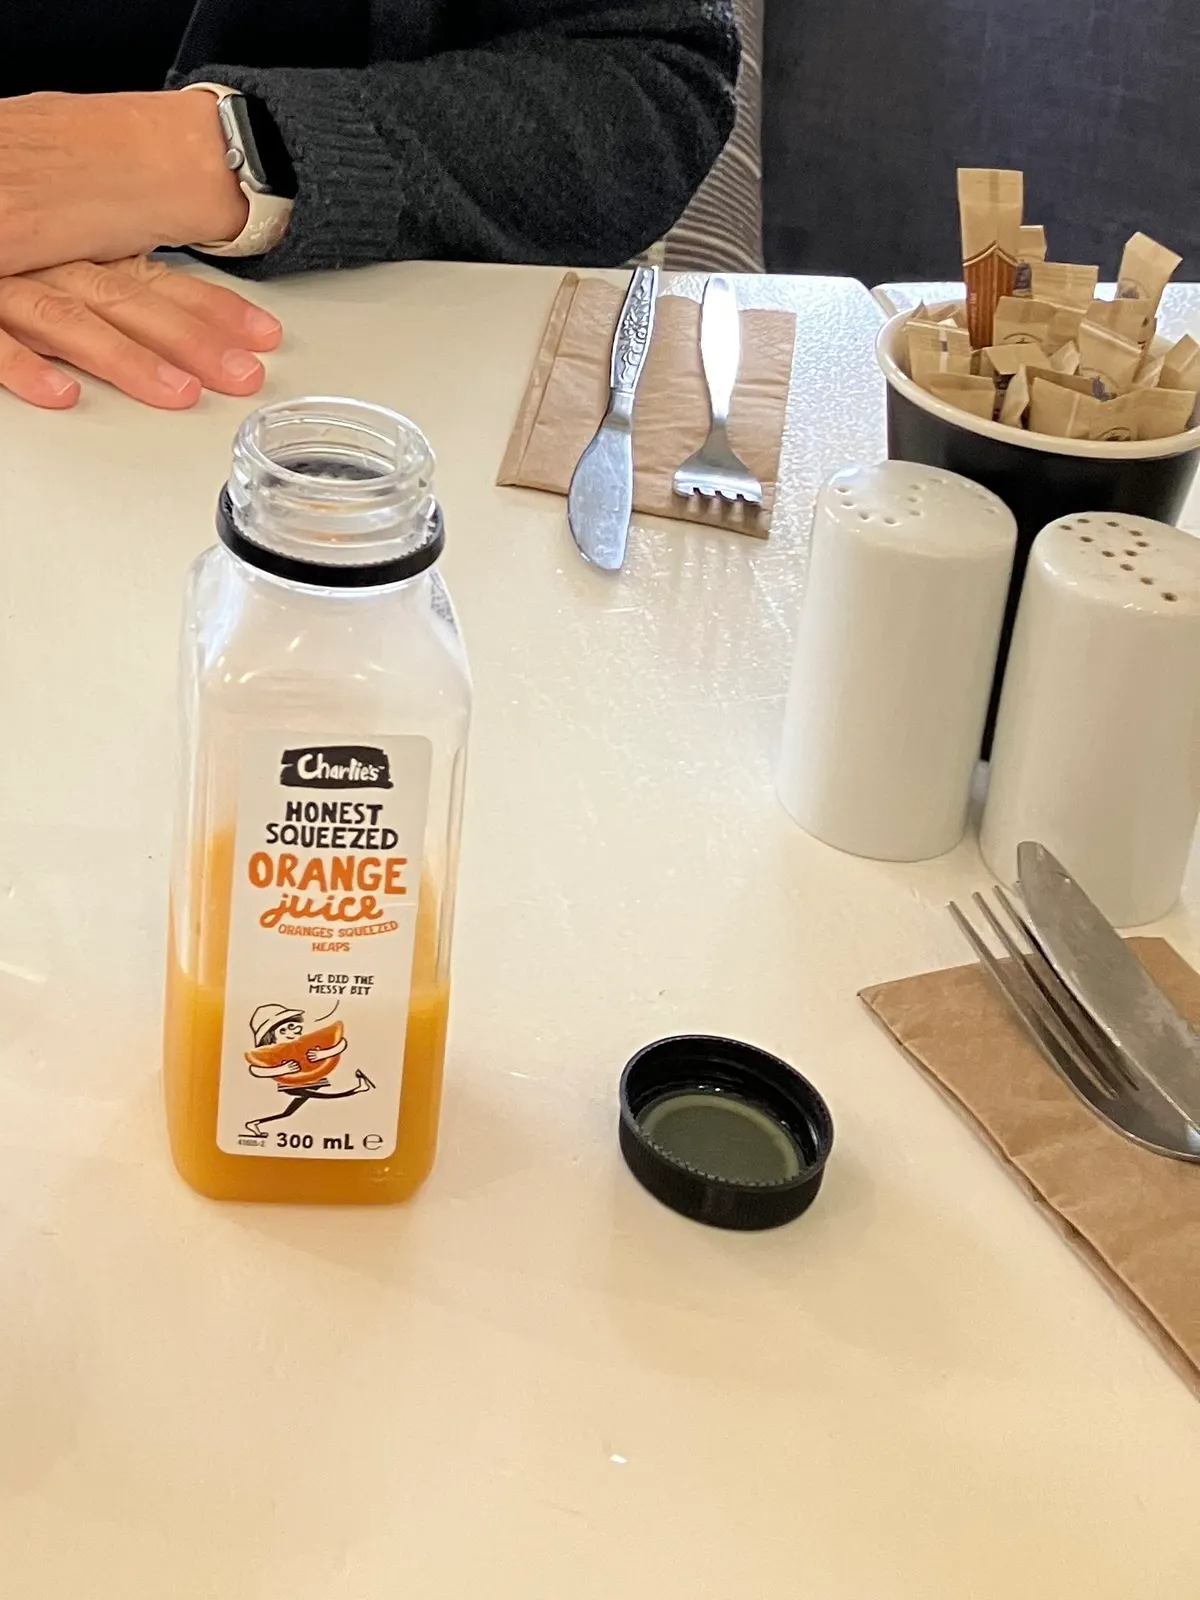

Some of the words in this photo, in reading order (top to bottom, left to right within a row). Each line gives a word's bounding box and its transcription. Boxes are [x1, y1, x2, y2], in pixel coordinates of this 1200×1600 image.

[297, 753, 380, 782] Charlie's
[285, 801, 383, 825] HONEST
[266, 823, 399, 850] SQUEEZED
[248, 852, 408, 895] ORANGE
[260, 893, 383, 928] juice
[278, 923, 334, 939] ORANGES
[338, 920, 399, 938] SQUEEZED
[311, 942, 351, 952] HEAPS
[307, 973, 324, 983] WE
[327, 974, 349, 984] DID
[353, 975, 375, 985] THE
[308, 984, 346, 995] MESSY
[350, 985, 372, 995] BIT
[276, 1132, 314, 1149] 300
[323, 1133, 354, 1150] mL
